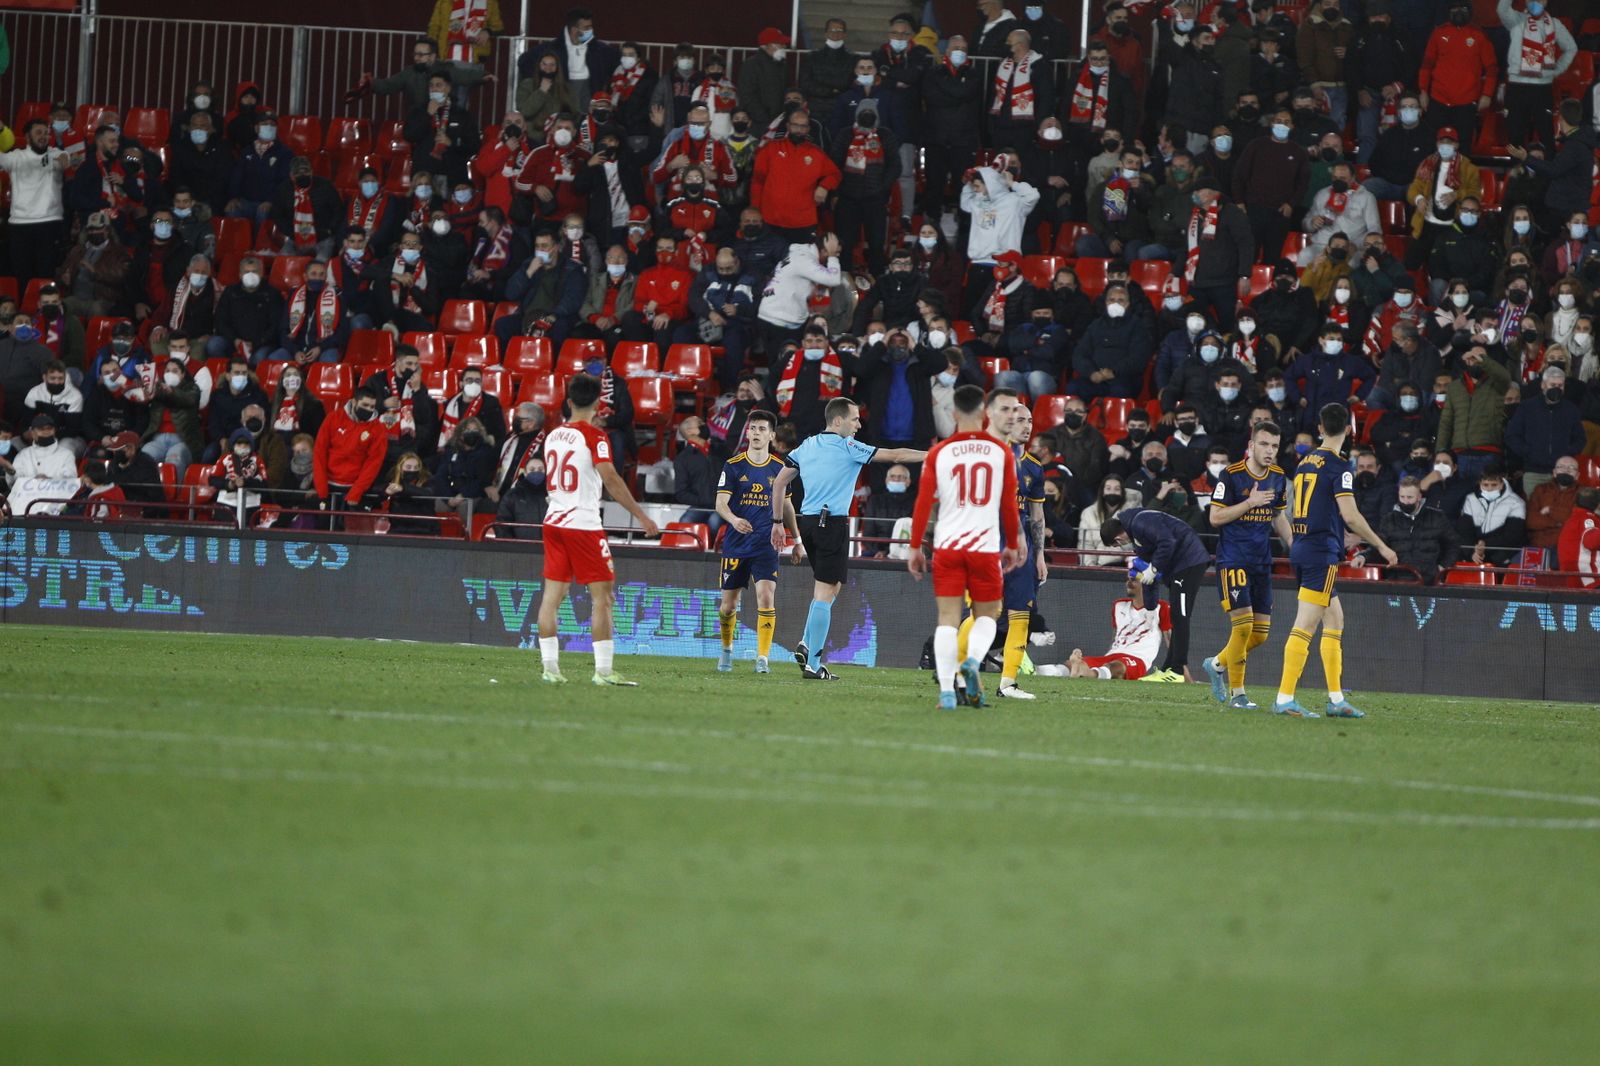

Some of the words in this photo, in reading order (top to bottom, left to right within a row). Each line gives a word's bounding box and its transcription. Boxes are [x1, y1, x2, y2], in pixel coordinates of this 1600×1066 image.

[951, 442, 991, 457] CURRO
[546, 448, 579, 493] 26
[950, 461, 993, 509] 10
[1294, 472, 1318, 519] 17
[724, 557, 740, 571] 19
[1228, 568, 1247, 587] 10
